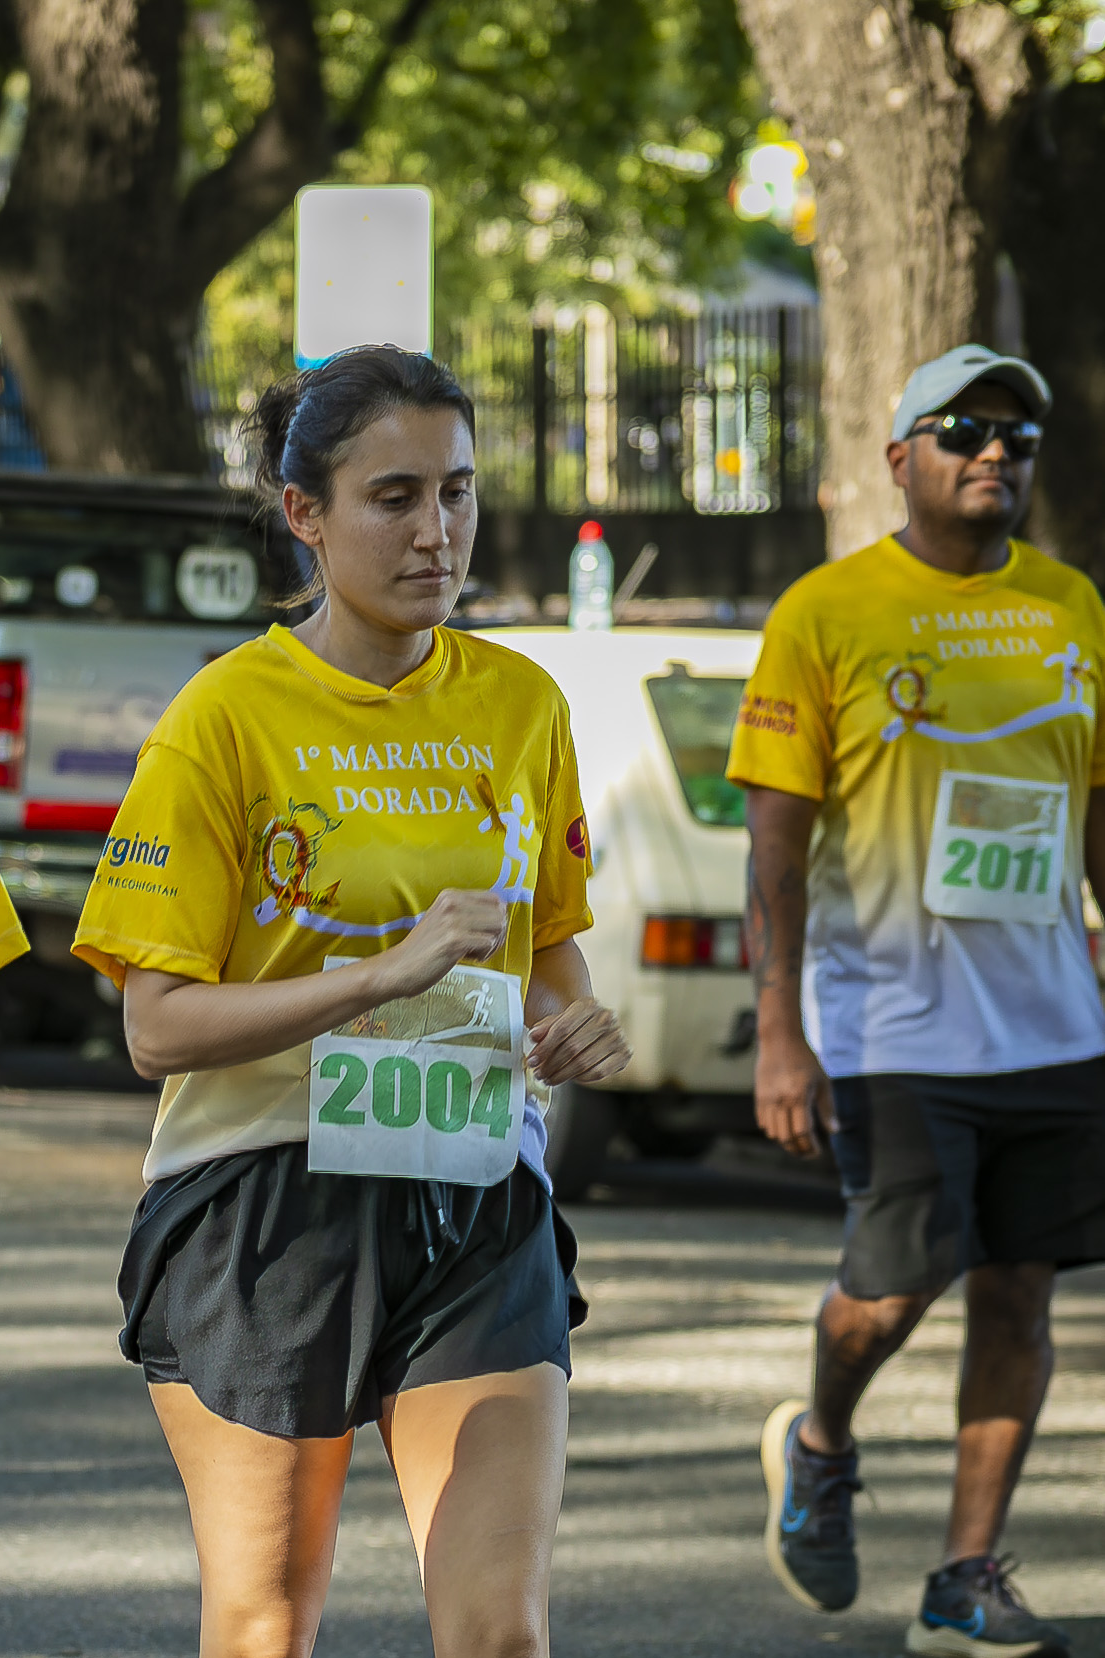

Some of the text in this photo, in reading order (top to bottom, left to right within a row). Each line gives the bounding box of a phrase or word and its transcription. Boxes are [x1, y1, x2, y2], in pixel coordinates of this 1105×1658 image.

[935, 604, 1054, 632] MARATÓN
[937, 637, 1042, 661] DORADA
[328, 734, 495, 772] MARATÓN
[333, 785, 478, 815] DORADA
[942, 837, 1052, 894] 2011
[318, 1052, 513, 1140] 2004
